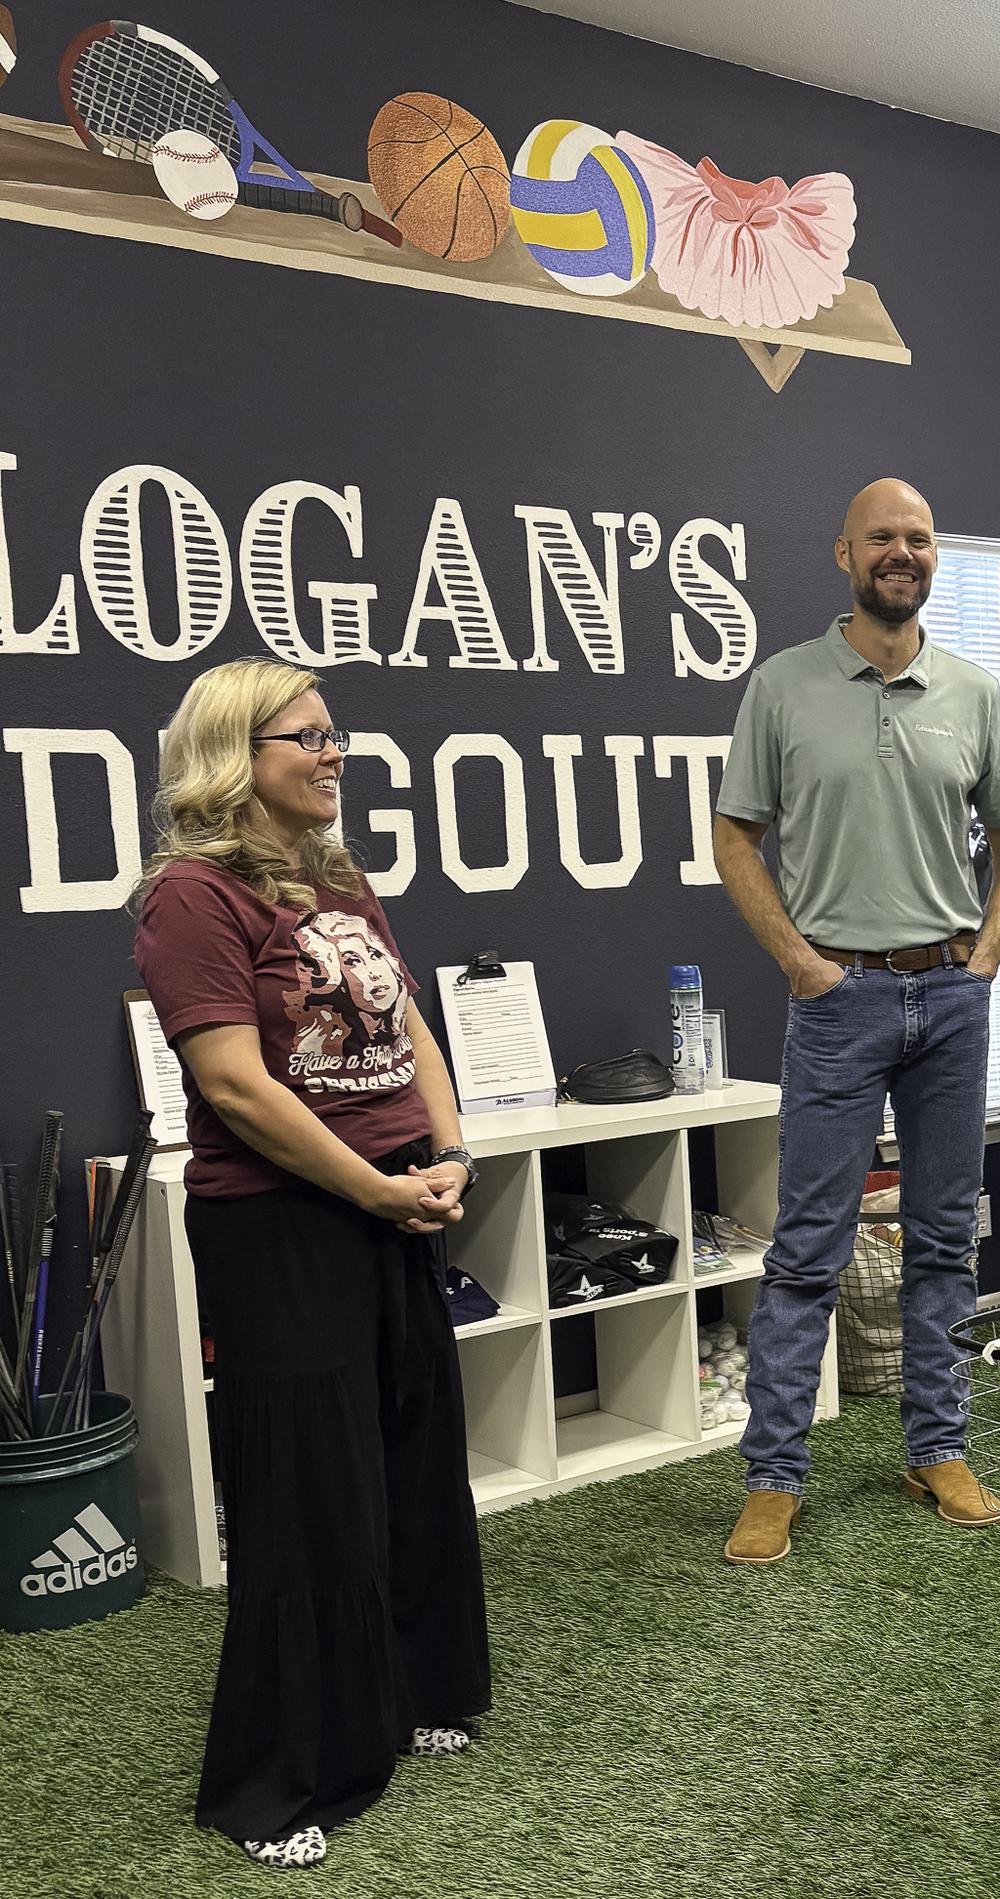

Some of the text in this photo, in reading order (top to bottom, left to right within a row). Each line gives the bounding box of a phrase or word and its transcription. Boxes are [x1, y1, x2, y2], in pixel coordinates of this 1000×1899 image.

[0, 451, 758, 682] LOGAN'S
[3, 728, 734, 914] DGOUT
[288, 1051, 343, 1077] Have
[20, 1545, 138, 1597] adidas
